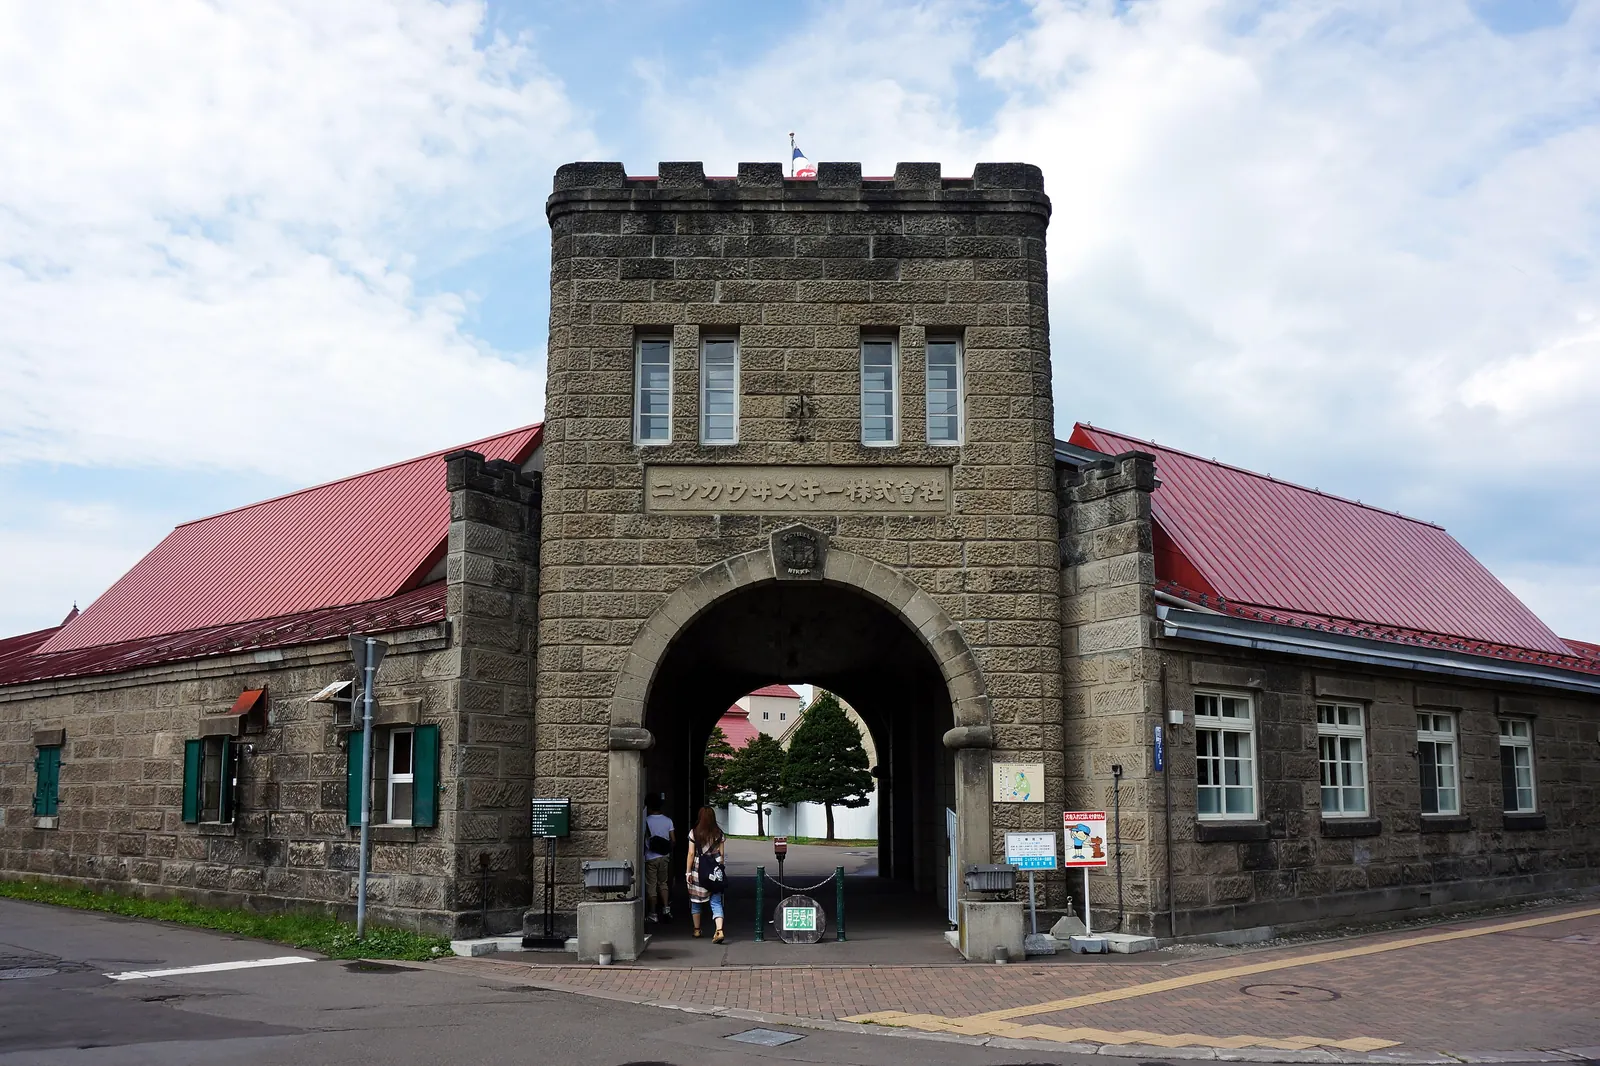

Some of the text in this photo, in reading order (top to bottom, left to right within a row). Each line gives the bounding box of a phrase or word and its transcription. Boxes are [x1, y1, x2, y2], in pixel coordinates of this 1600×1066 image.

[652, 478, 944, 503] ニッカウヰスキー株式會社
[787, 567, 811, 575] NIKKA
[786, 909, 813, 927] 見学受付
